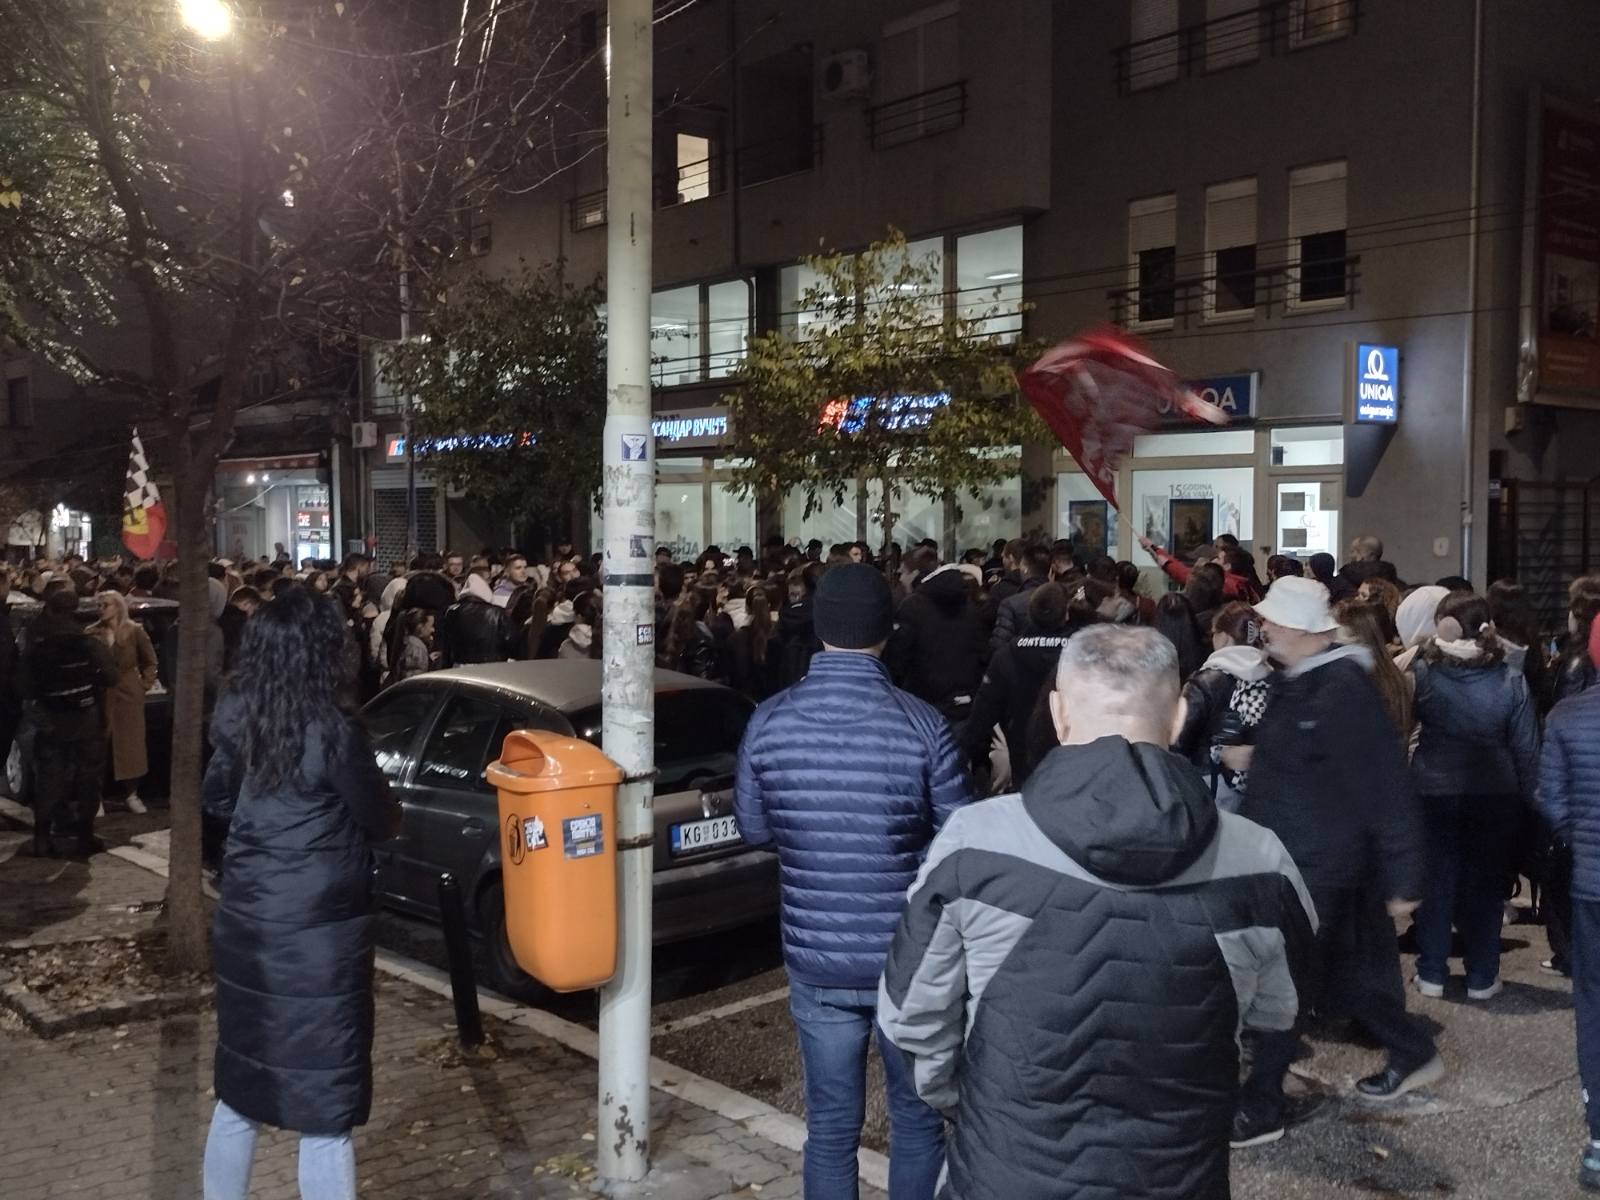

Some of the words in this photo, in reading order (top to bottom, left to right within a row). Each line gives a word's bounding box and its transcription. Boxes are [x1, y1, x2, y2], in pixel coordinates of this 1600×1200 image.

[1360, 383, 1394, 401] UNIQA
[1168, 484, 1182, 497] 15
[683, 826, 701, 845] KG
[712, 818, 737, 839] 033
